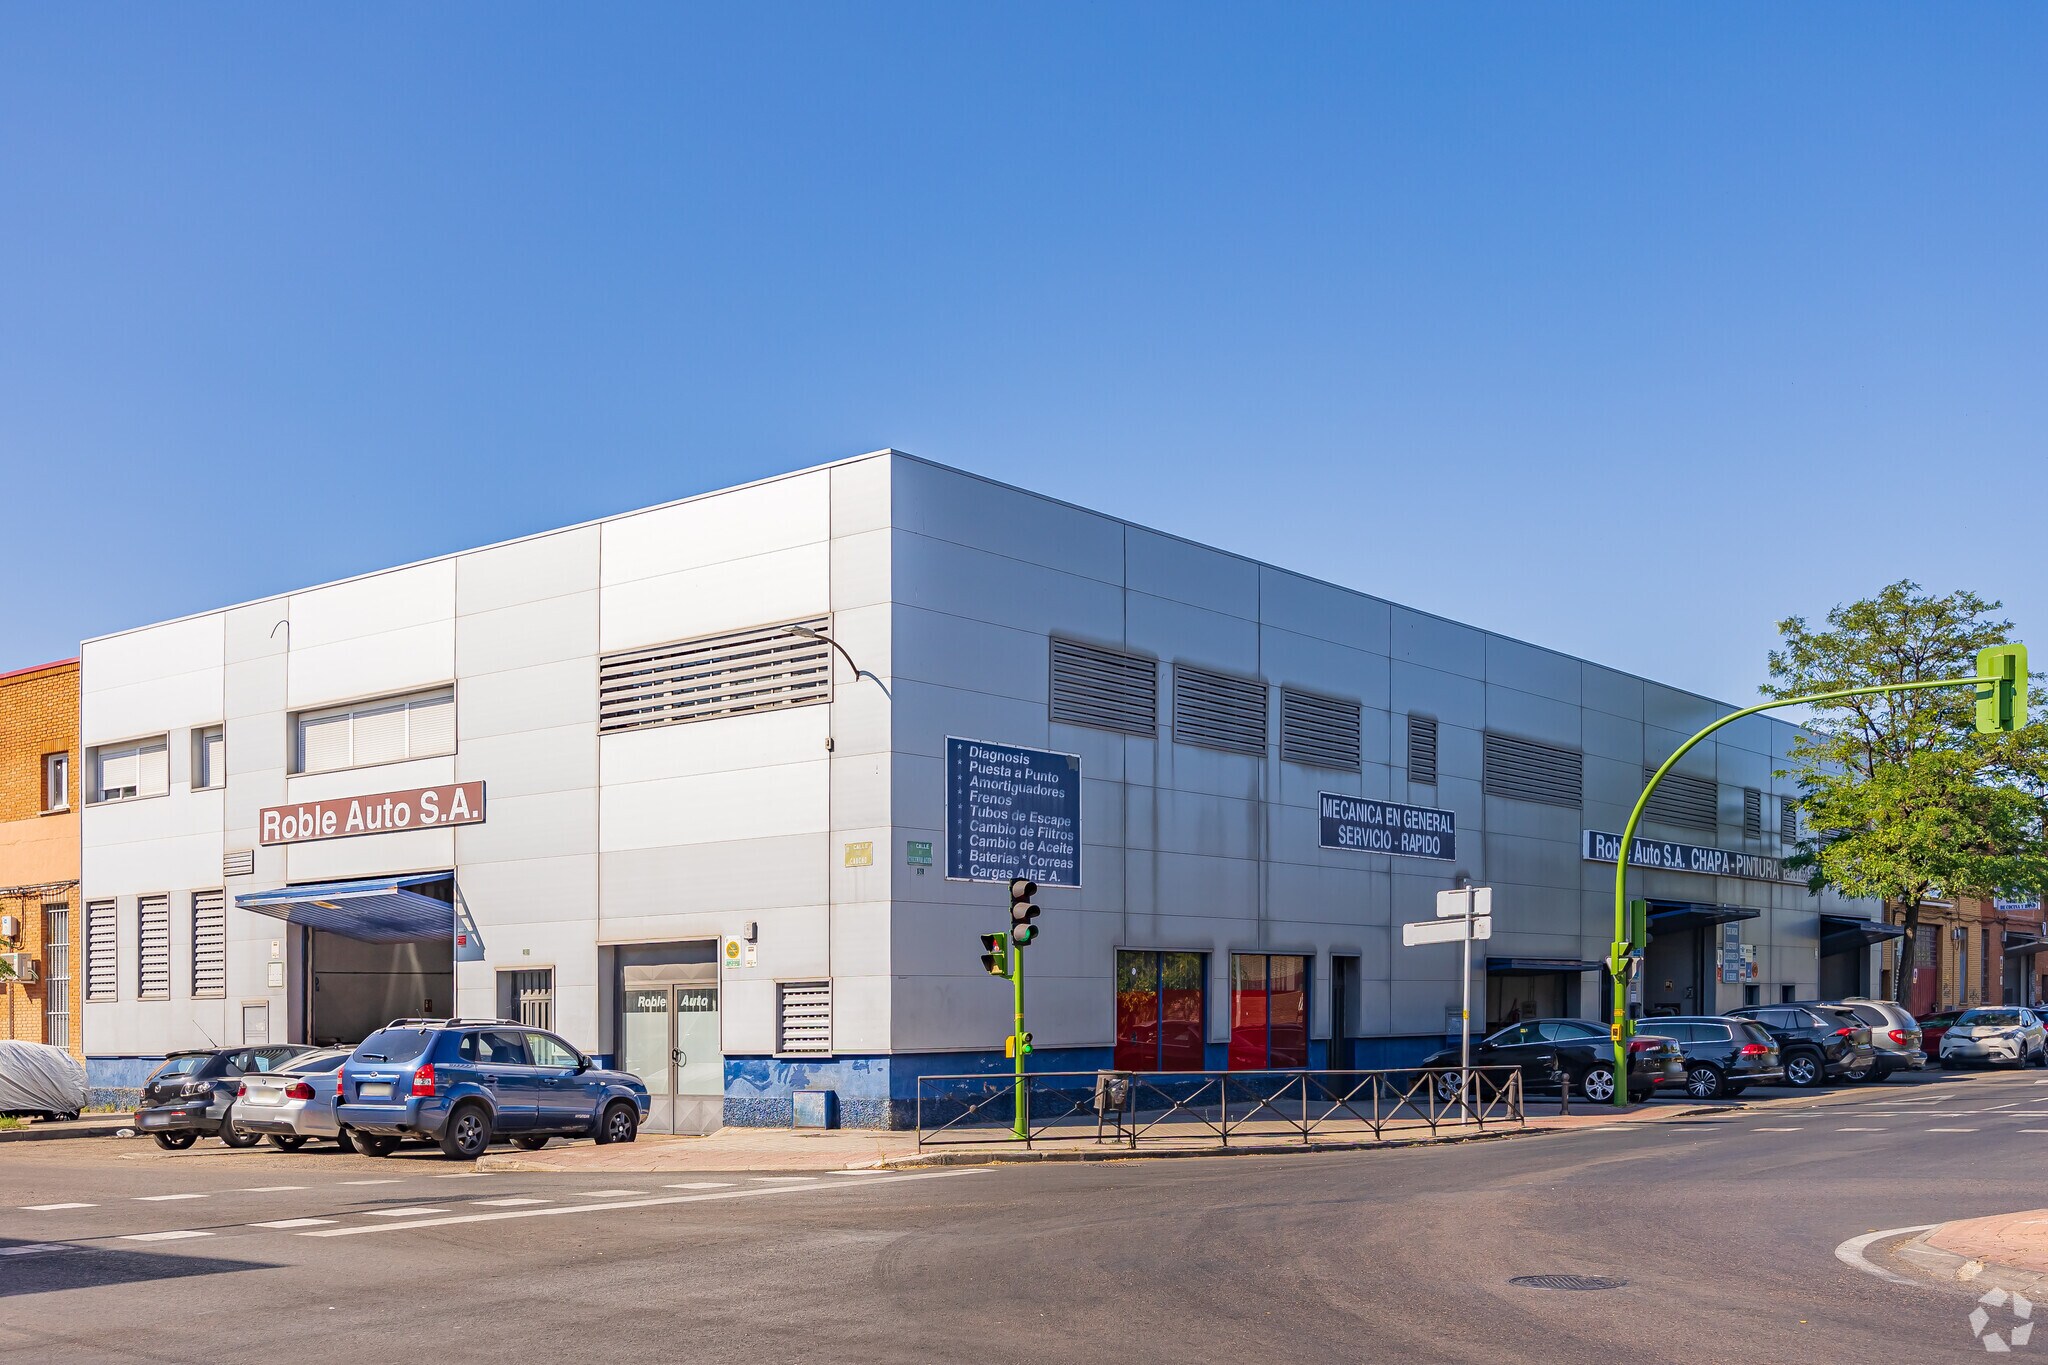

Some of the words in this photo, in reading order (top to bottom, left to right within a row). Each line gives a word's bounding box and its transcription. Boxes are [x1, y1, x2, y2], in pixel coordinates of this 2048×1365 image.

[969, 746, 1030, 765] Diagnosis
[969, 761, 1011, 777] Puesta
[1014, 771, 1022, 779] a
[1025, 768, 1059, 783] Punto
[969, 775, 1065, 798] Amortiguadores
[969, 790, 1012, 806] Frenos
[263, 805, 337, 841] Roble
[345, 798, 411, 832] Auto
[419, 787, 479, 825] S.A.
[970, 804, 1008, 820] Tubos
[1011, 810, 1026, 821] de
[1030, 811, 1071, 828] Escape
[1322, 797, 1383, 825] MECANICA
[1386, 807, 1401, 828] EN
[1403, 809, 1454, 834] GENERAL
[969, 820, 1016, 835] Cambio
[1020, 825, 1034, 837] de
[1037, 826, 1074, 841] Filtros
[1338, 824, 1392, 850] SERVICIO
[1401, 833, 1441, 855] RAPIDO
[969, 834, 1017, 850] Cambio
[1020, 839, 1035, 851] de
[1037, 841, 1073, 854] Aceite
[1596, 834, 1631, 861] Rob
[1634, 840, 1661, 865] Auto
[1663, 844, 1685, 868] S.A.
[969, 849, 1020, 865] Baterias
[1028, 854, 1074, 869] Correas
[970, 864, 1013, 880] Cargas
[1017, 868, 1046, 881] AIRE
[1049, 870, 1061, 882] A.
[637, 996, 667, 1008] Roble
[680, 995, 709, 1007] Auto
